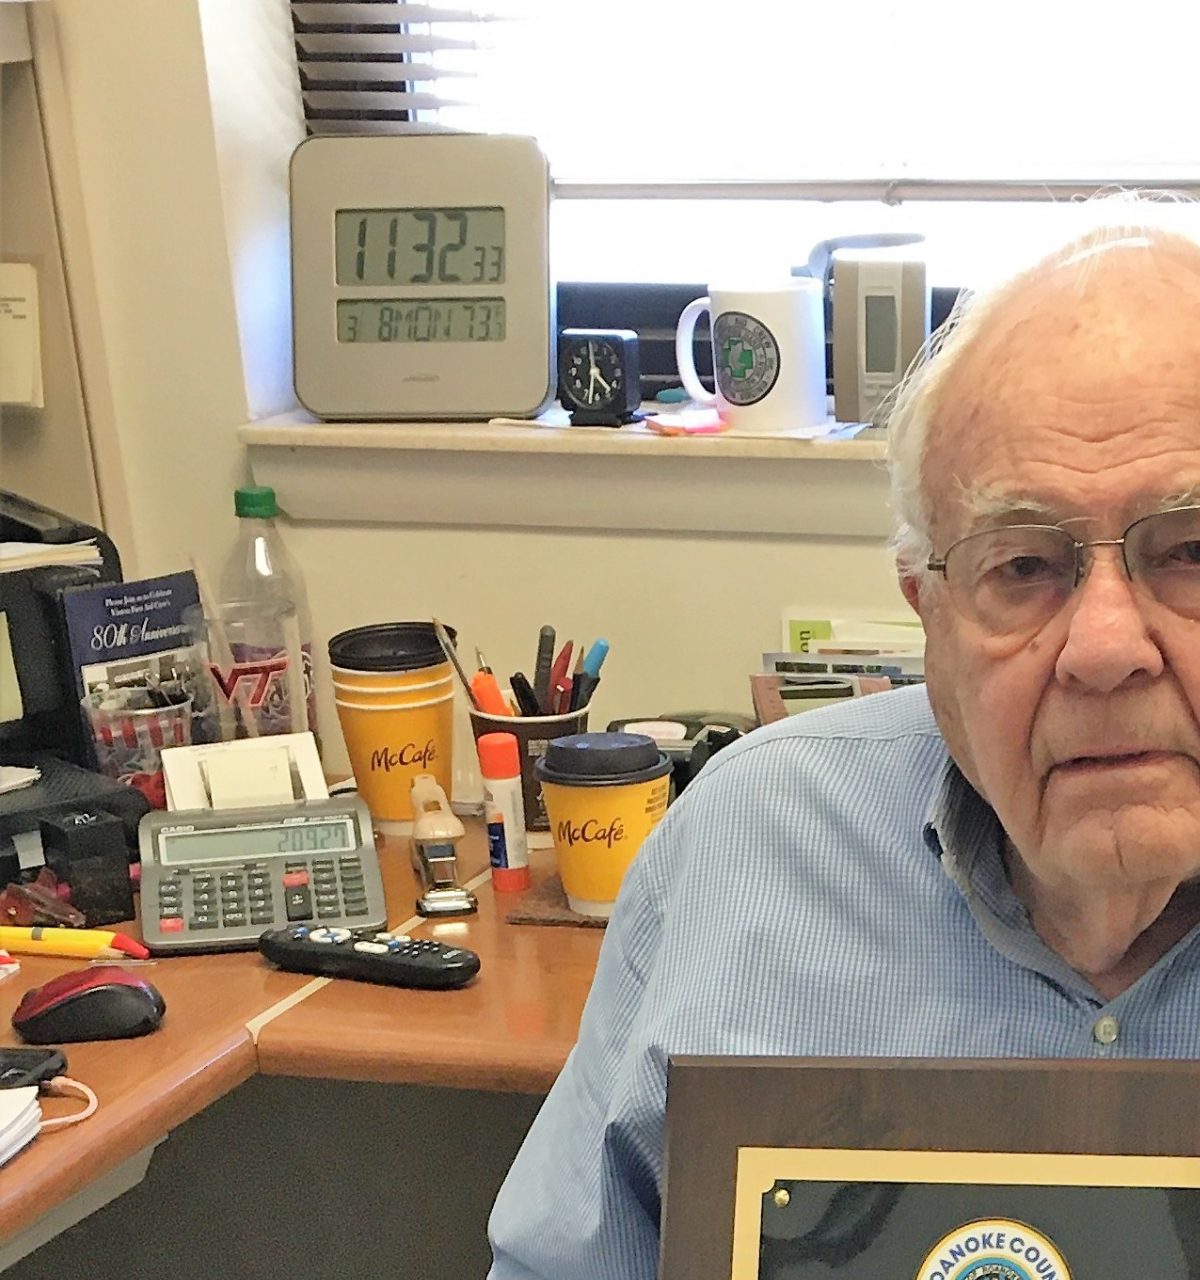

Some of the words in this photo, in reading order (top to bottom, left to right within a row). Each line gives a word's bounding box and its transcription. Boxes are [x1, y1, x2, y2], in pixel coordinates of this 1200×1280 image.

[207, 656, 289, 708] VT
[371, 739, 436, 772] McCafé
[558, 817, 624, 849] McCafé
